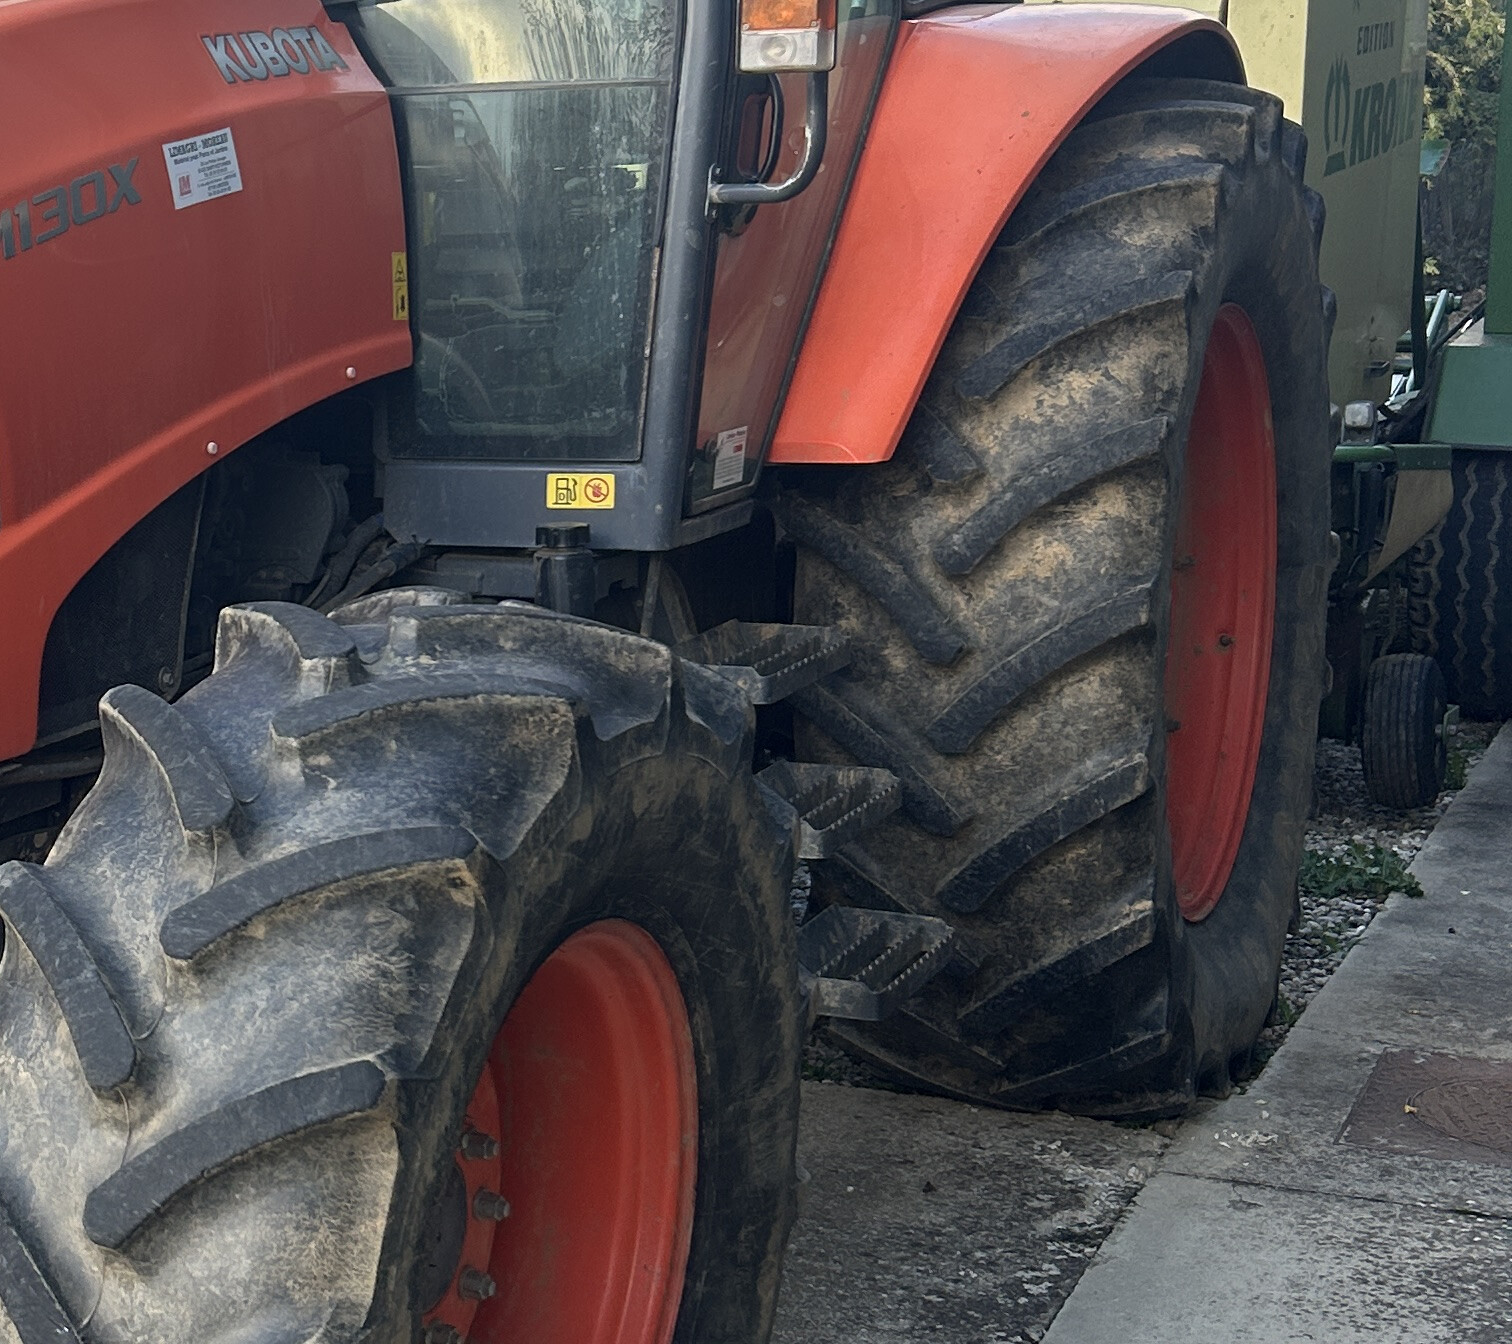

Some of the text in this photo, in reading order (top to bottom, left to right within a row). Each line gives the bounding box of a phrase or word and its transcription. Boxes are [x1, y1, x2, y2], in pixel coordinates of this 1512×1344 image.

[201, 25, 351, 84] KUBOTA
[1356, 21, 1395, 56] EDITION
[1349, 71, 1419, 167] KRONE
